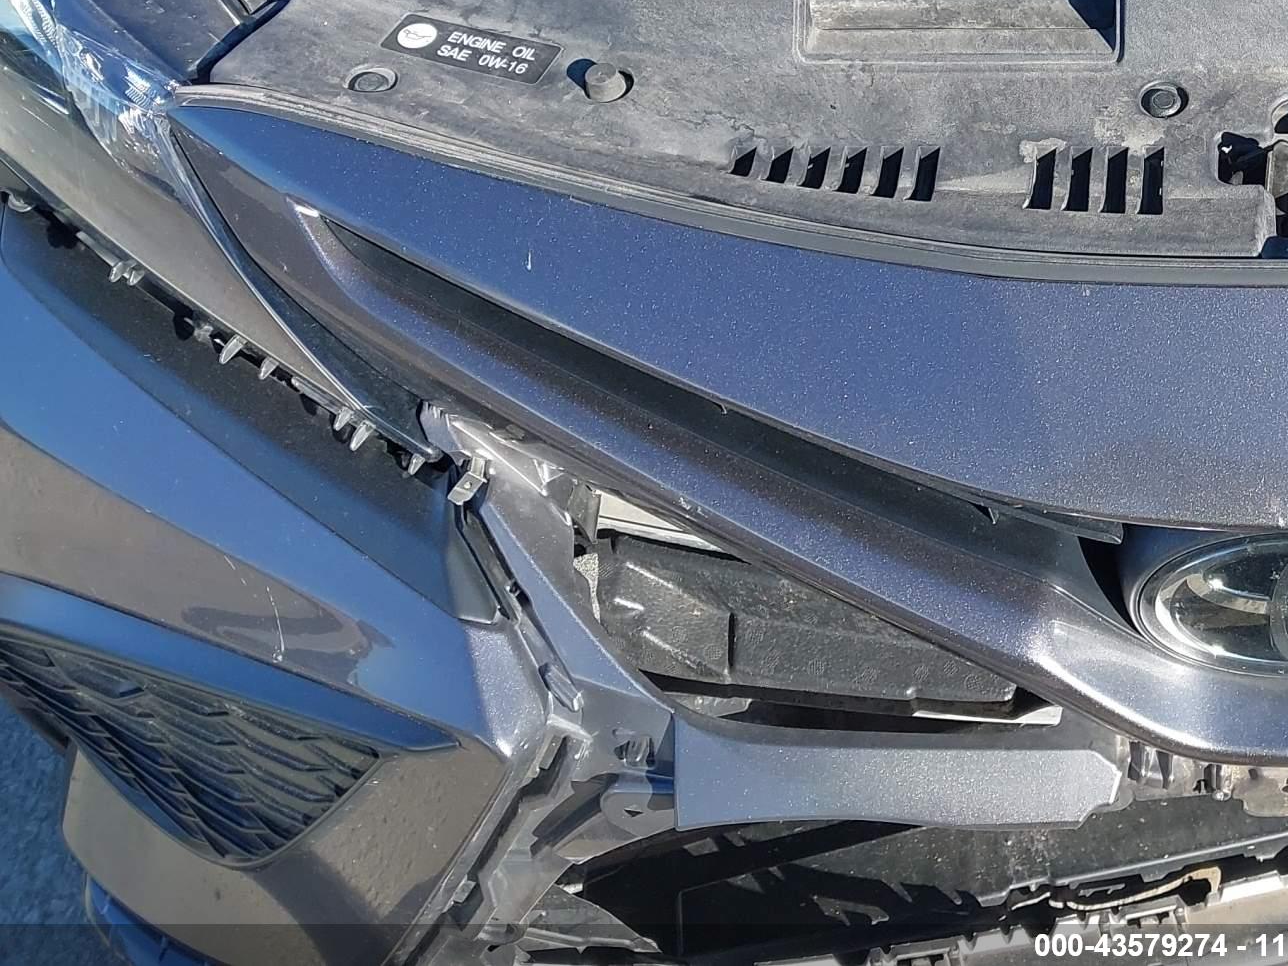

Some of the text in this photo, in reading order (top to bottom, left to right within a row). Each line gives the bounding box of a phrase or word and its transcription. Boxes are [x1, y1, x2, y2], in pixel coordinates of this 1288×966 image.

[437, 45, 528, 74] SAE 0W-16
[447, 31, 536, 61] ENGINE OIL
